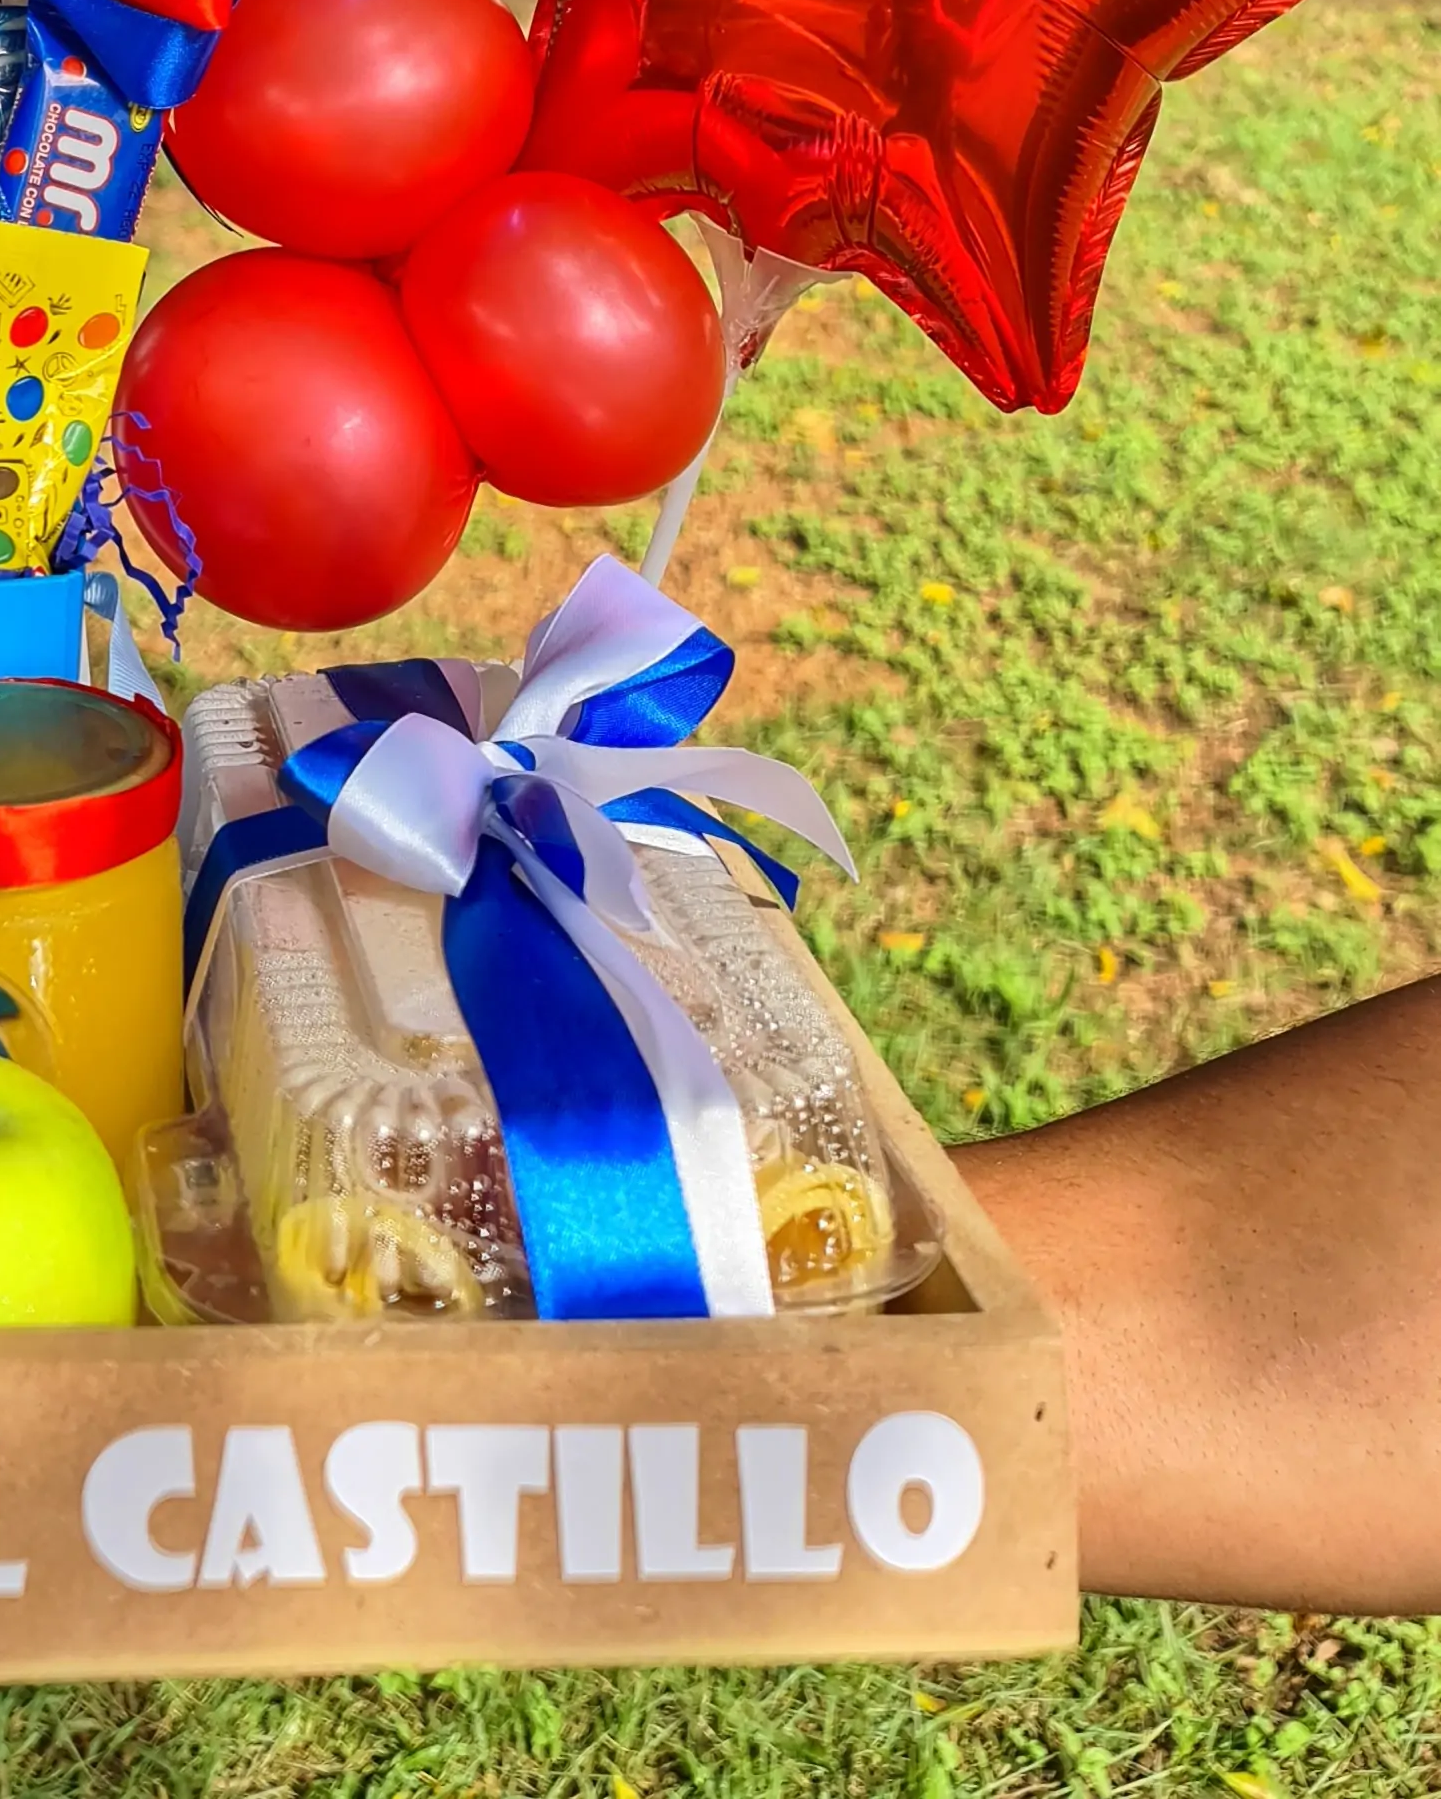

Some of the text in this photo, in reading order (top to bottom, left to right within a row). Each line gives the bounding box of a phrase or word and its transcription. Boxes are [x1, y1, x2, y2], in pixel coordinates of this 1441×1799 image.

[29, 103, 62, 186] CHOCOLATE
[19, 187, 39, 222] CON
[81, 1409, 986, 1593] CASTILLO
